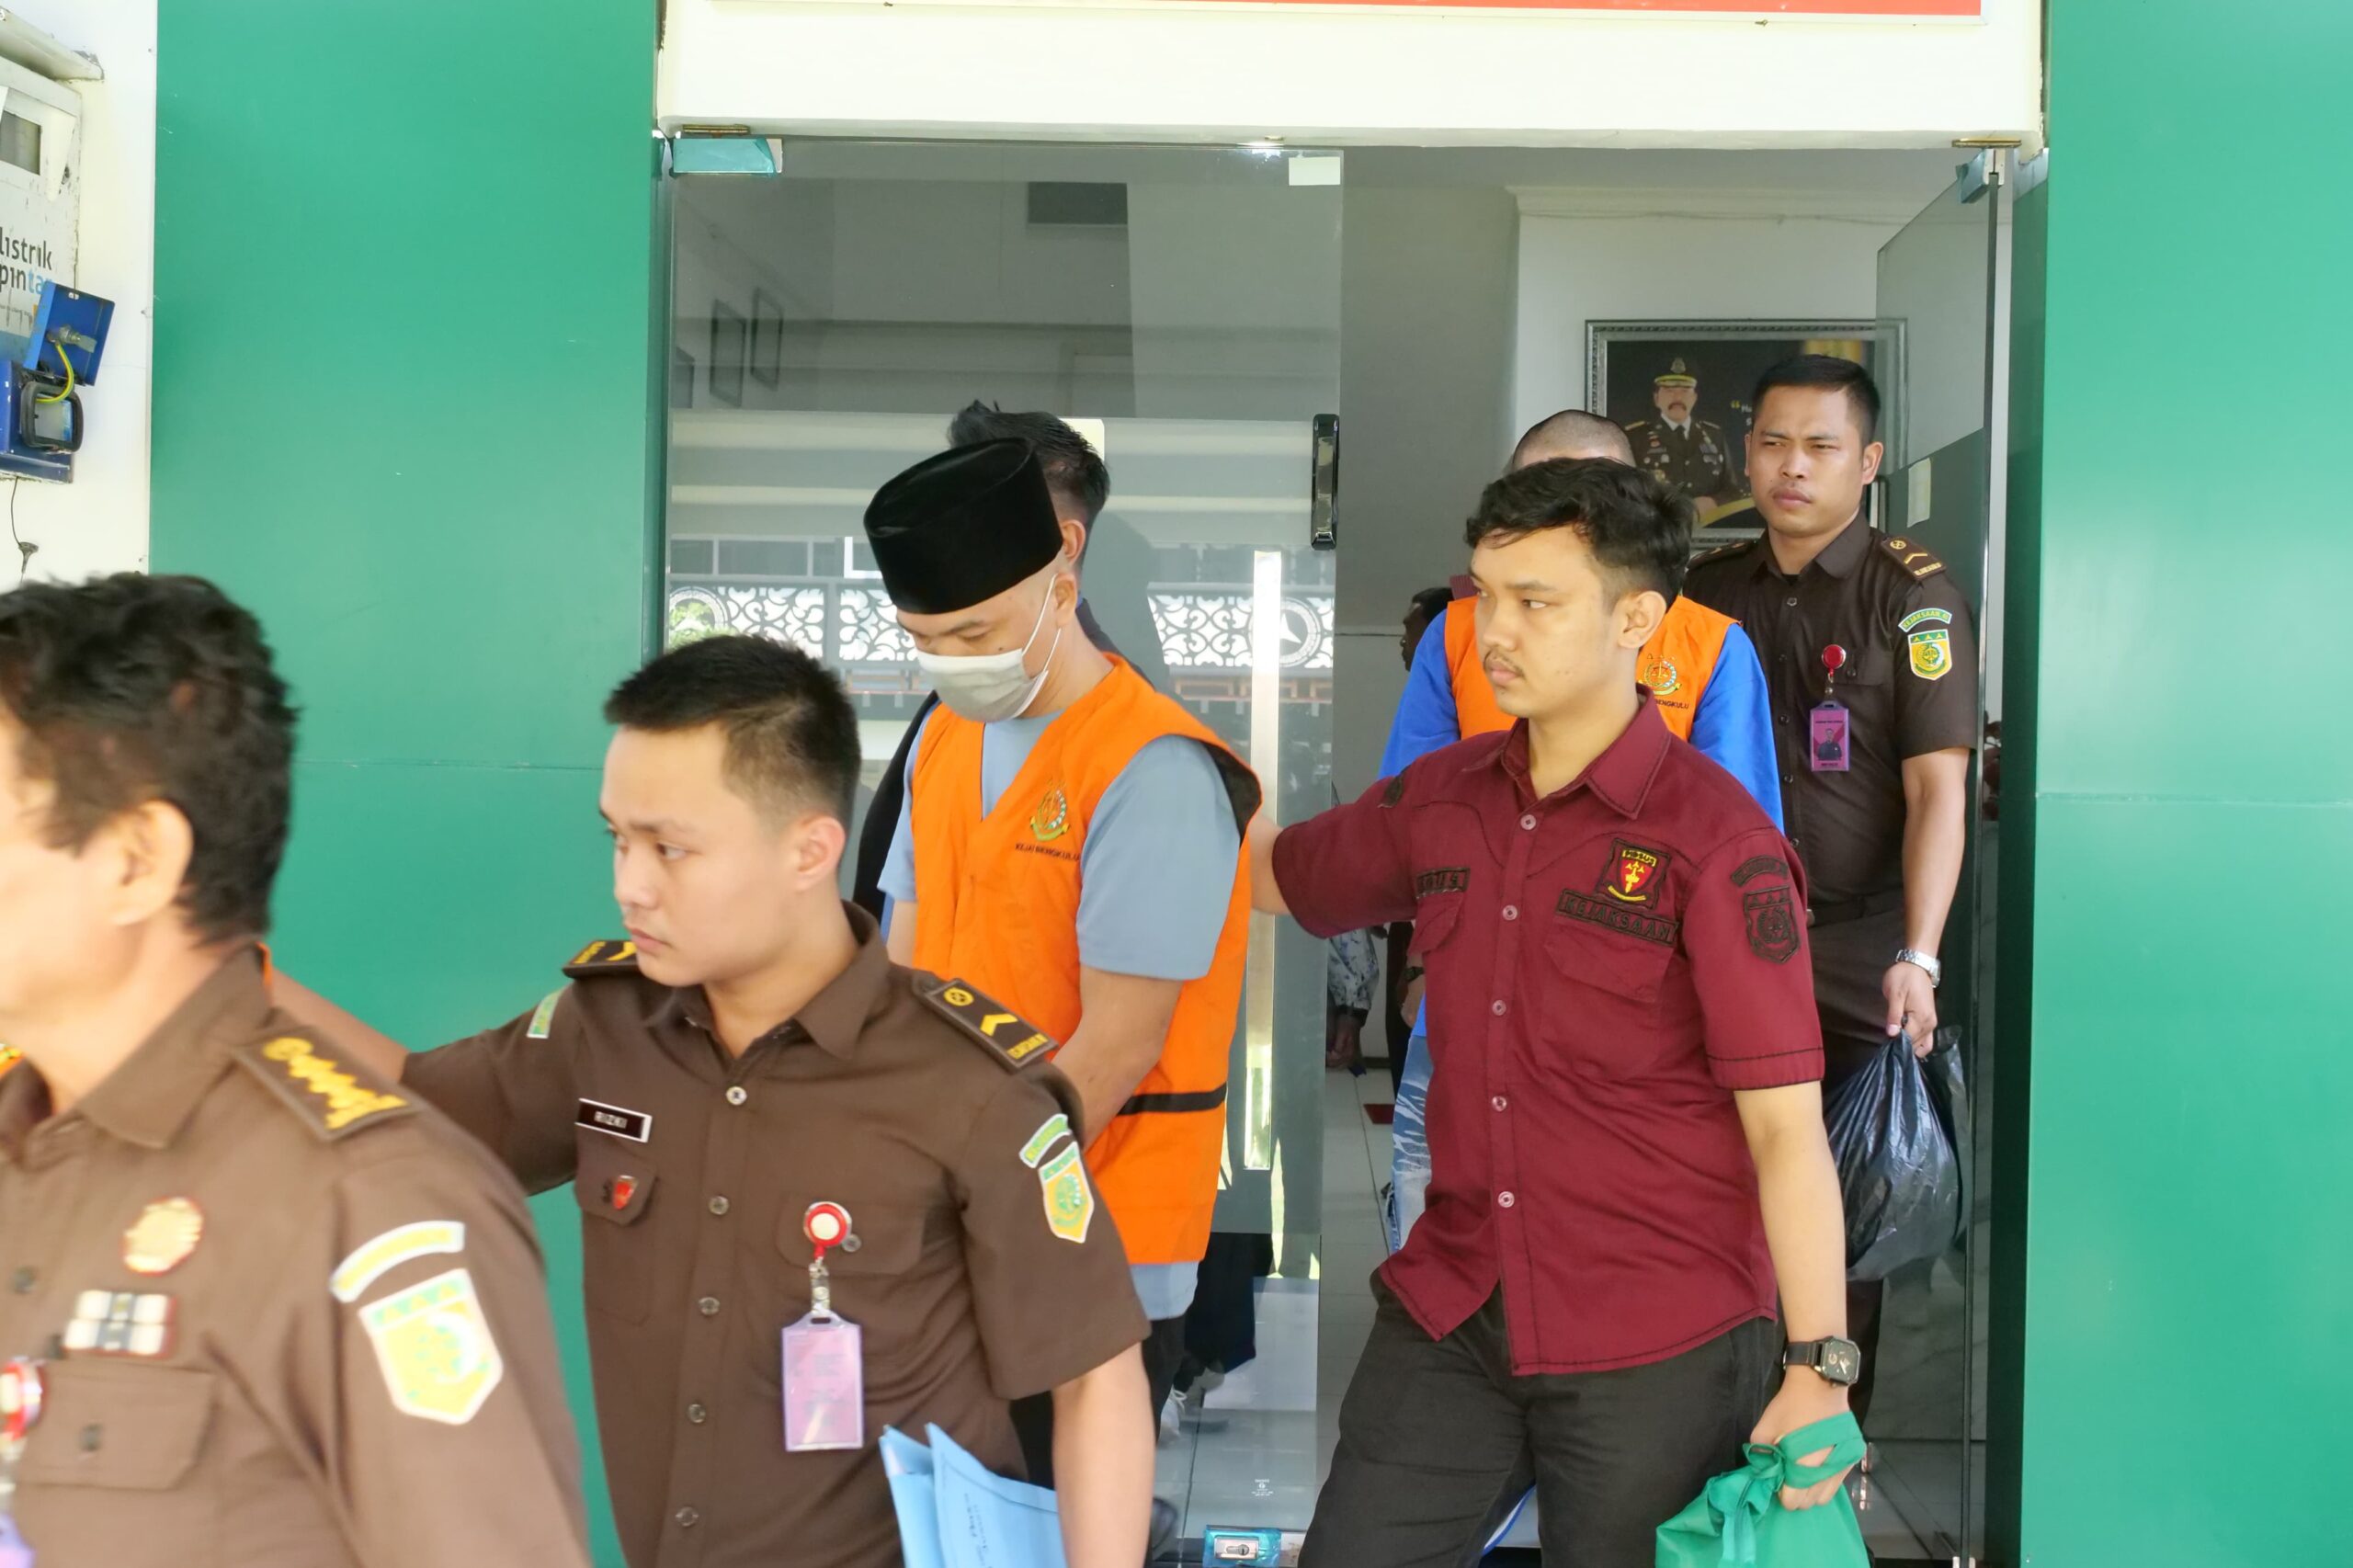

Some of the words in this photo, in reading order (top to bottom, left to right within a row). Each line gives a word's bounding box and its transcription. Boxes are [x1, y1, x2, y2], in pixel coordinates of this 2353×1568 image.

[0, 226, 52, 271] listrik
[0, 263, 52, 295] pinta
[1564, 895, 1670, 938] KEJAKSAAN
